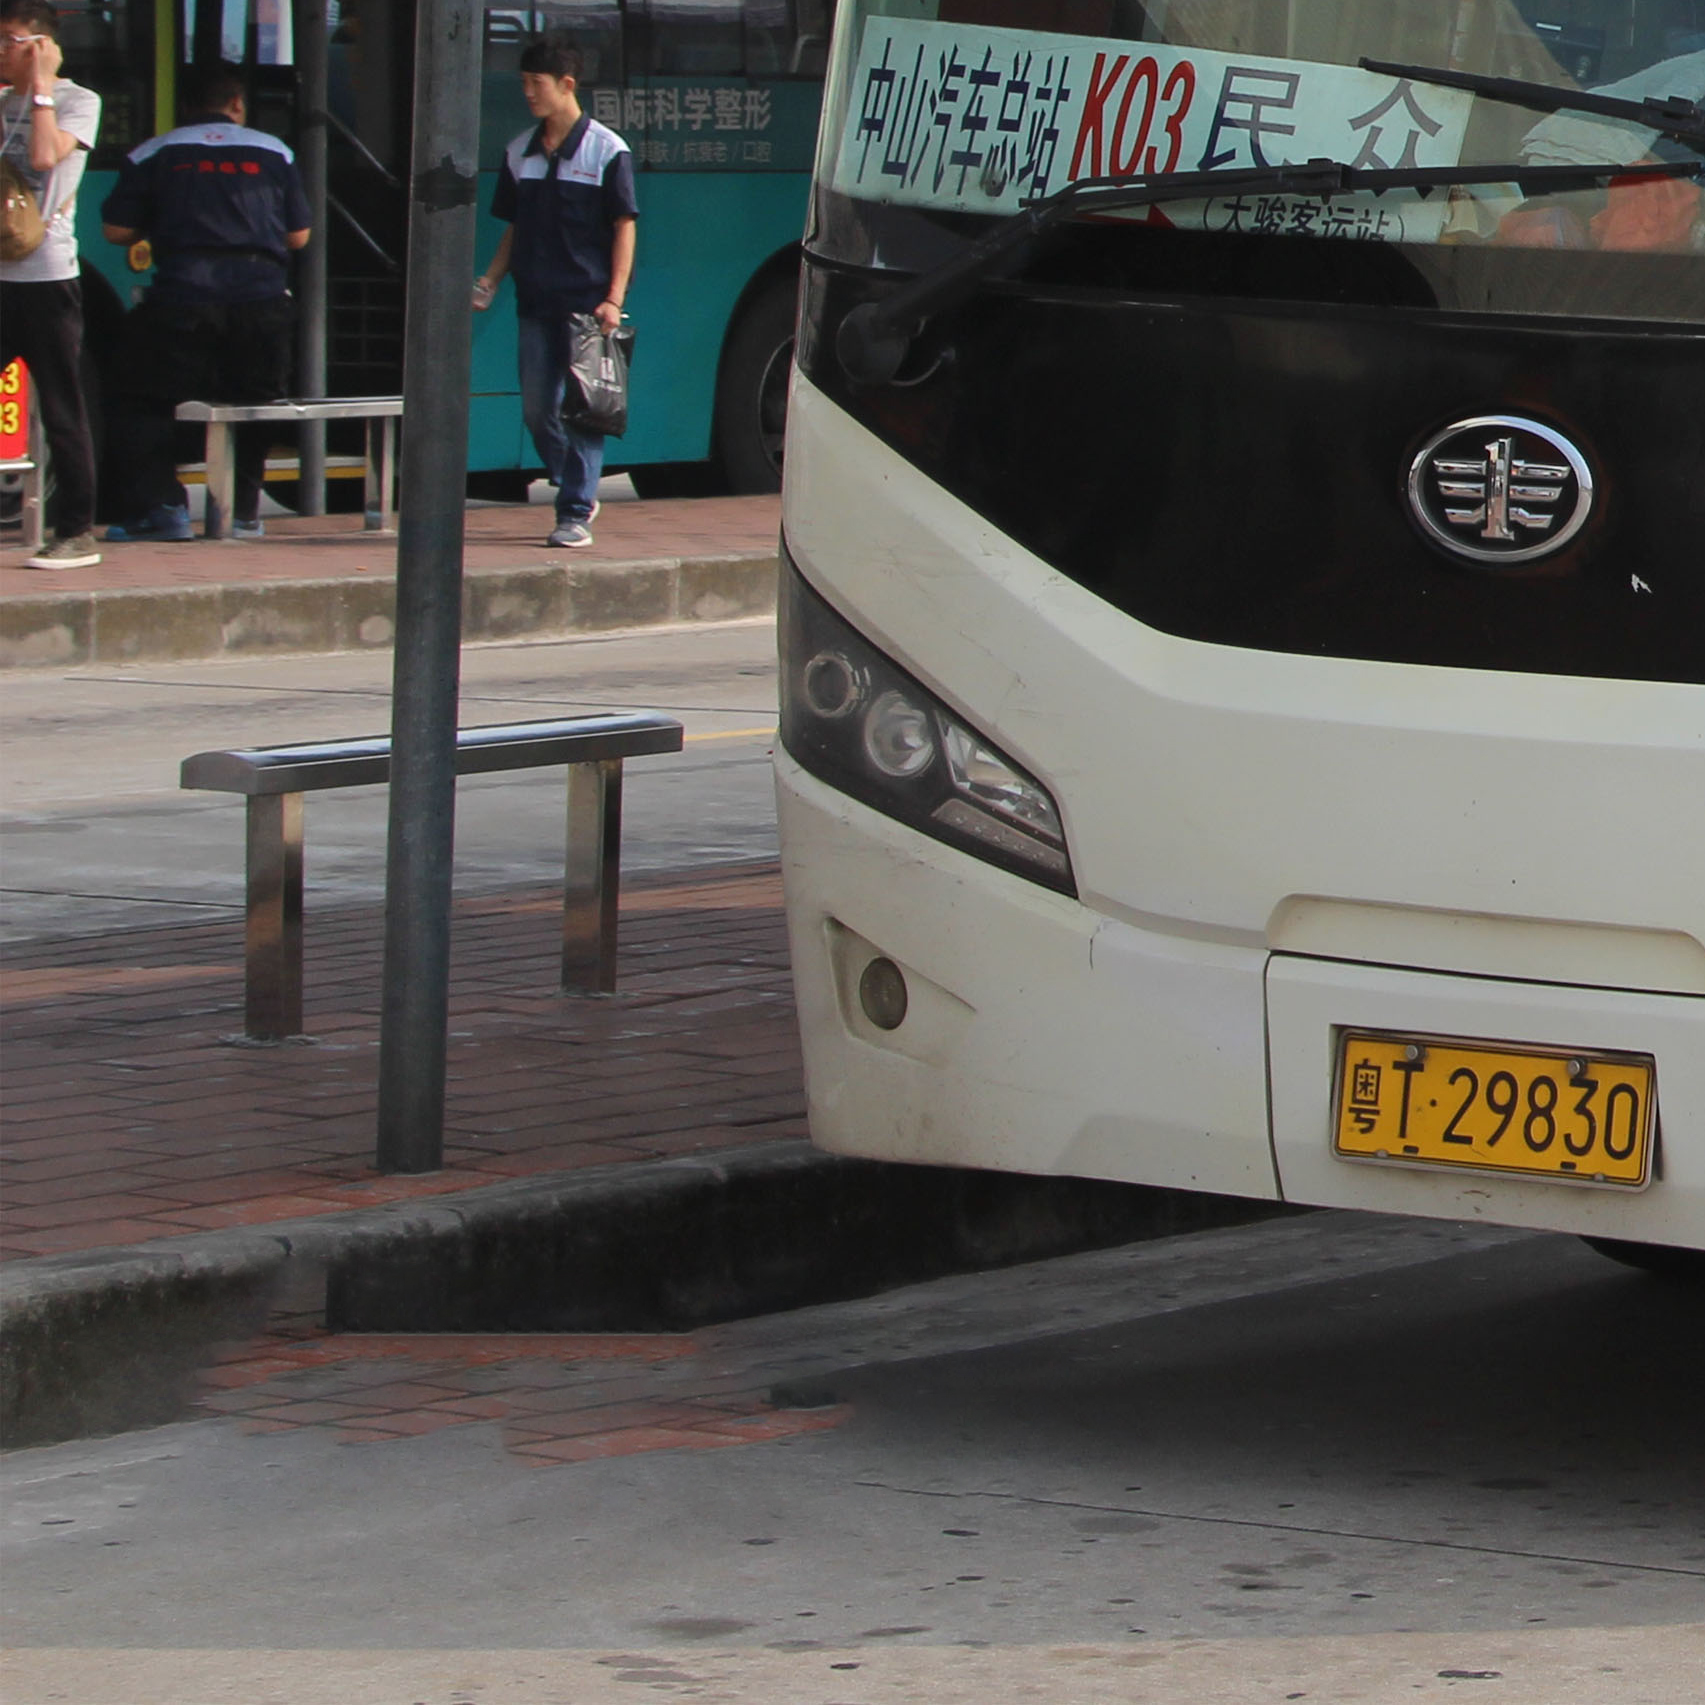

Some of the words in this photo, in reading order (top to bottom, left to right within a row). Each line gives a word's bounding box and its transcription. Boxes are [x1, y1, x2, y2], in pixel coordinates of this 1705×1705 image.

[592, 87, 772, 131] 国际科学整形
[855, 37, 1071, 192] 中山汽车总站
[1068, 52, 1196, 187] K03
[1197, 66, 1444, 200] 民众
